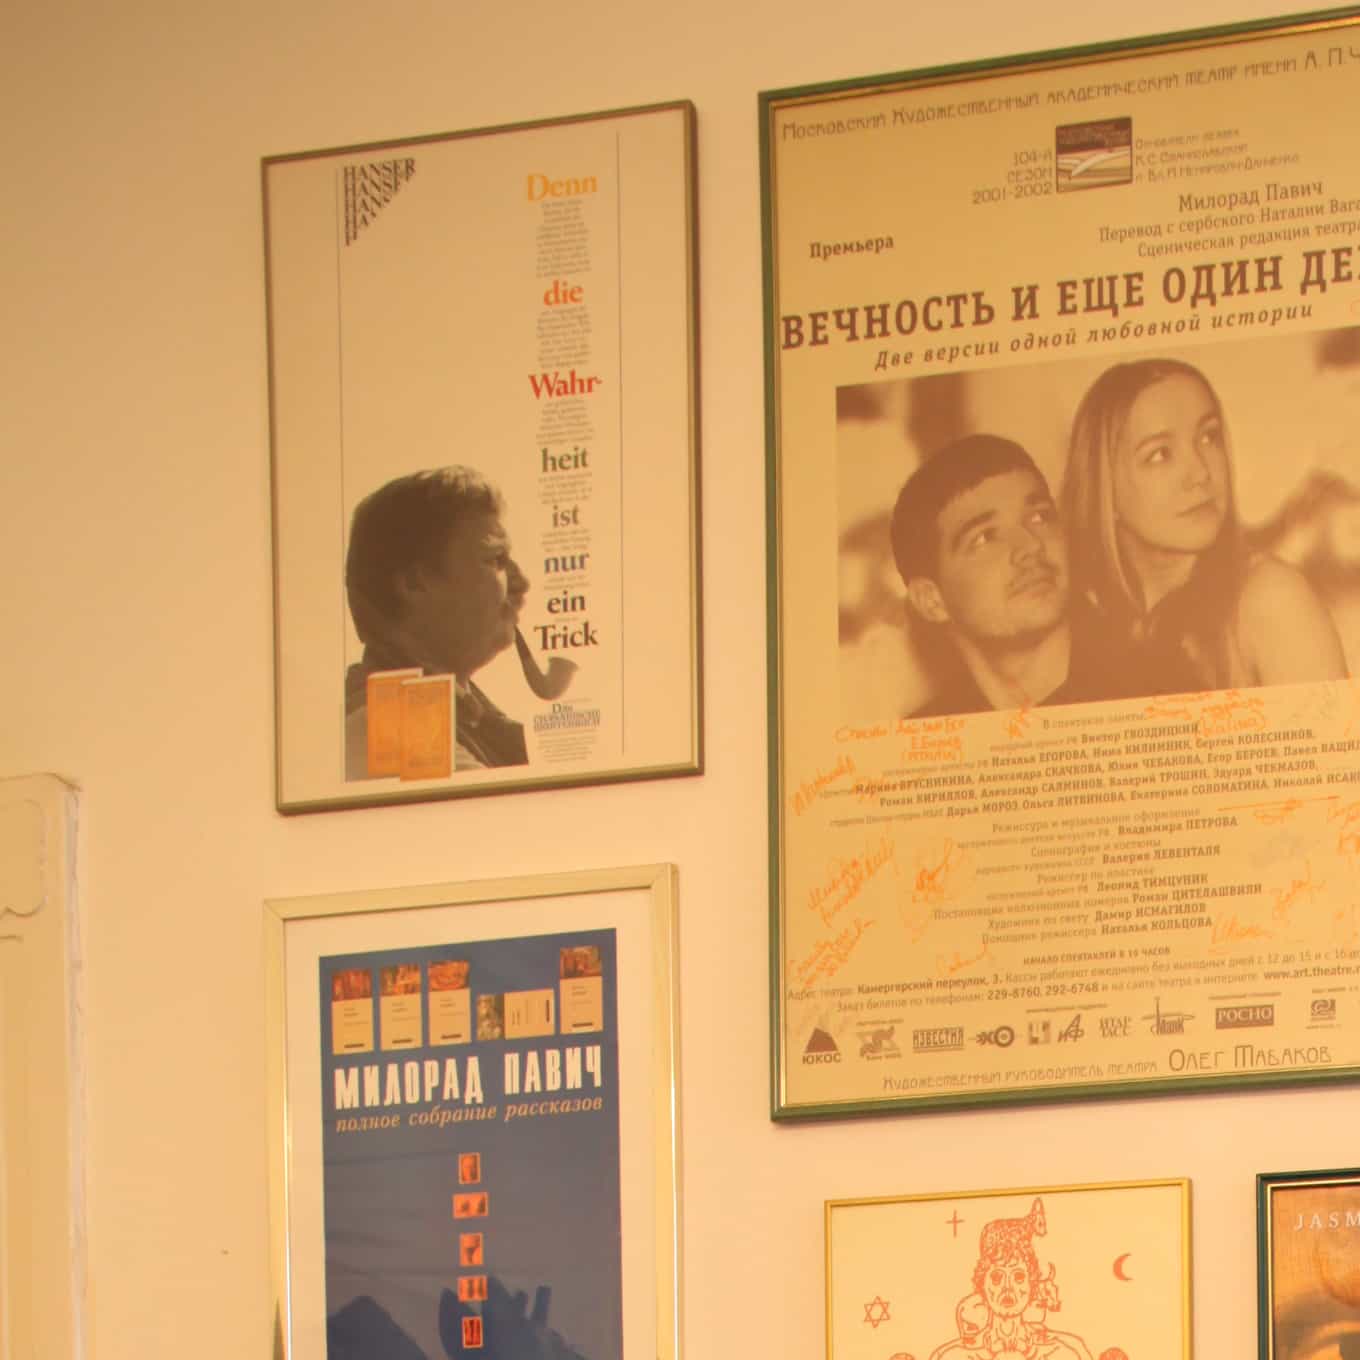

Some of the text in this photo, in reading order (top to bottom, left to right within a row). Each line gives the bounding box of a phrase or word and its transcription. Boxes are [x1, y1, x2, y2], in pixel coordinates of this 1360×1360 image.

[526, 172, 598, 203] Denn
[972, 183, 1053, 206] 2001-2002
[1178, 181, 1323, 213] Милорад Павич
[1099, 223, 1162, 245] Перевод
[1178, 210, 1255, 234] сербского
[1260, 203, 1325, 224] Наталии
[809, 236, 895, 262] Премьера
[1137, 235, 1234, 258] Сценическая
[1239, 226, 1310, 248] редакция
[543, 279, 584, 306] die
[781, 290, 996, 351] ВЕЧНОСТЬ
[1010, 284, 1041, 322] И
[1056, 271, 1145, 319] ЕЩЕ
[1162, 254, 1284, 309] ОДИН
[874, 302, 1313, 372] Две версии одной любовной истории
[528, 368, 603, 401] Wahr-
[541, 446, 588, 473] heit
[551, 505, 580, 528] ist
[544, 552, 590, 574] nur
[546, 591, 586, 614] ein
[533, 621, 599, 652] Trick
[1216, 1005, 1273, 1024] РОСНО
[801, 1053, 842, 1065] ЮКОС
[333, 1044, 602, 1111] МИЛОРАД ПАВИЧ
[335, 1096, 603, 1133] полное собрание рассказов
